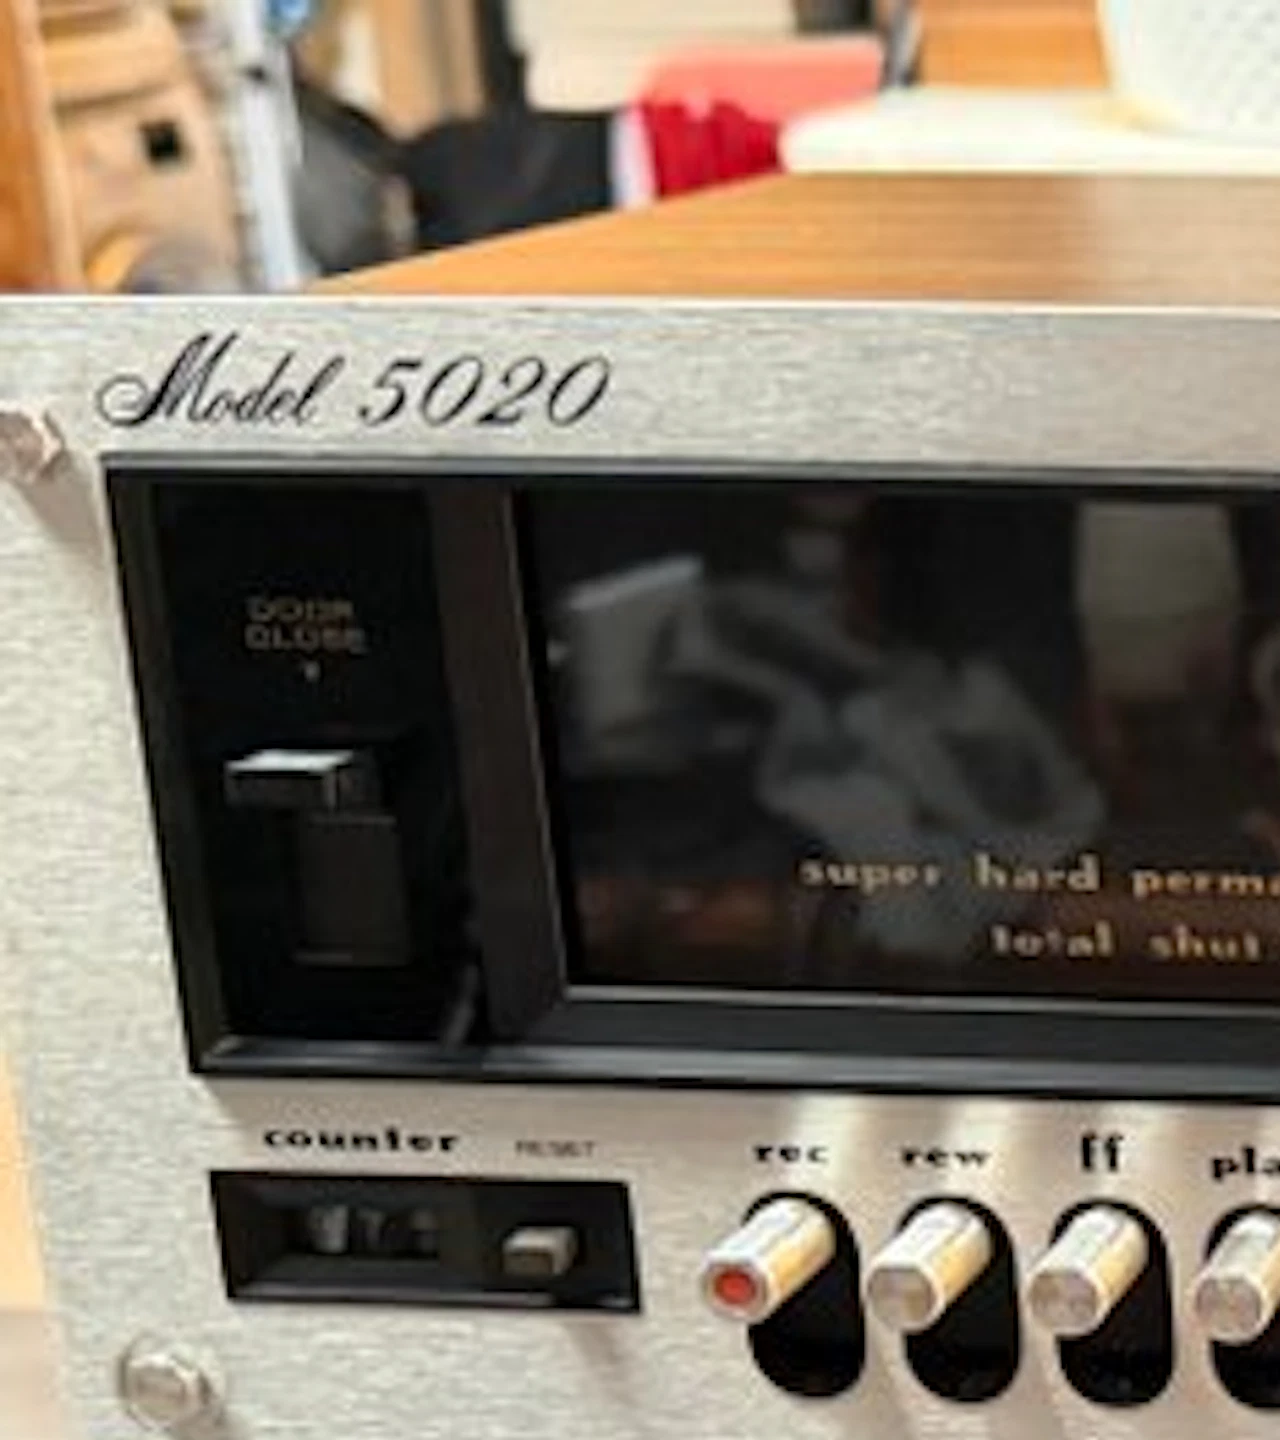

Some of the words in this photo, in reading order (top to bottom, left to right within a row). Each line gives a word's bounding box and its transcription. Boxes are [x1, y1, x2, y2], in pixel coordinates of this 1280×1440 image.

[95, 332, 346, 428] Model
[357, 355, 612, 428] 5020
[801, 858, 942, 893] super
[975, 853, 1100, 893] hard
[990, 921, 1112, 958] total
[1147, 924, 1262, 961] shut
[262, 1126, 460, 1156] counter
[514, 1139, 597, 1159] RESET
[751, 1138, 831, 1167] rec
[899, 1142, 992, 1170] rew
[1078, 1132, 1126, 1175] ff
